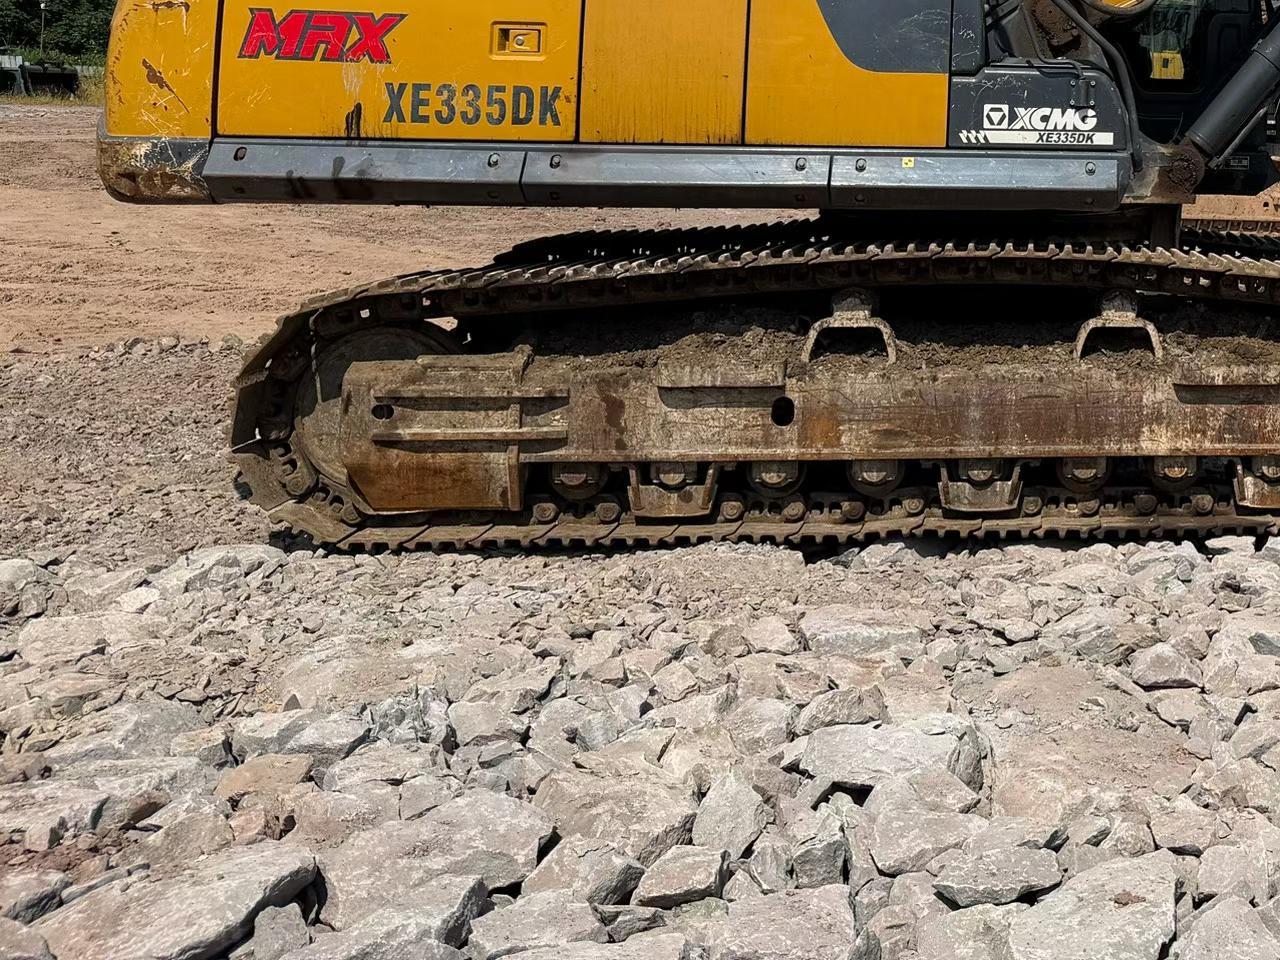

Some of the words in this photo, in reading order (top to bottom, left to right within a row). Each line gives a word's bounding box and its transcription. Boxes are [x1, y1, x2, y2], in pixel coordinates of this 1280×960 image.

[382, 82, 563, 127] XE335DK
[1008, 107, 1098, 131] XCMG
[1036, 132, 1095, 144] XE335DK
